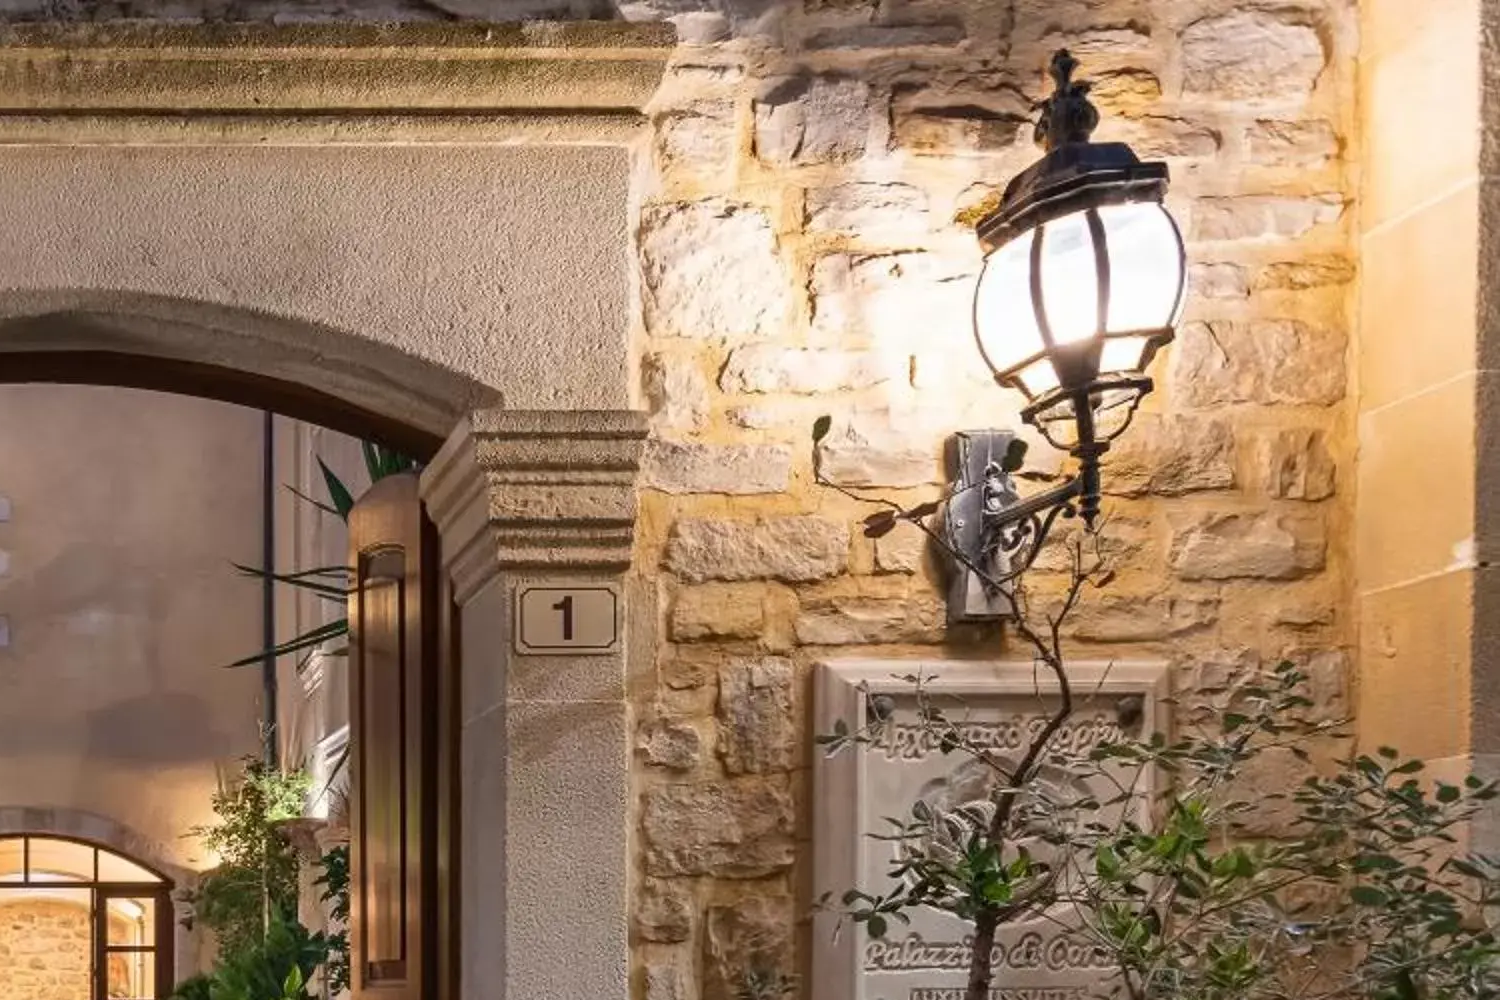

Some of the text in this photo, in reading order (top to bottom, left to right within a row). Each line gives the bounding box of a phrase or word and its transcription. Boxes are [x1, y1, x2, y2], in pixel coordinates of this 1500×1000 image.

[553, 595, 573, 640] 1
[864, 932, 1004, 971] Palazzio
[1008, 932, 1042, 969] di
